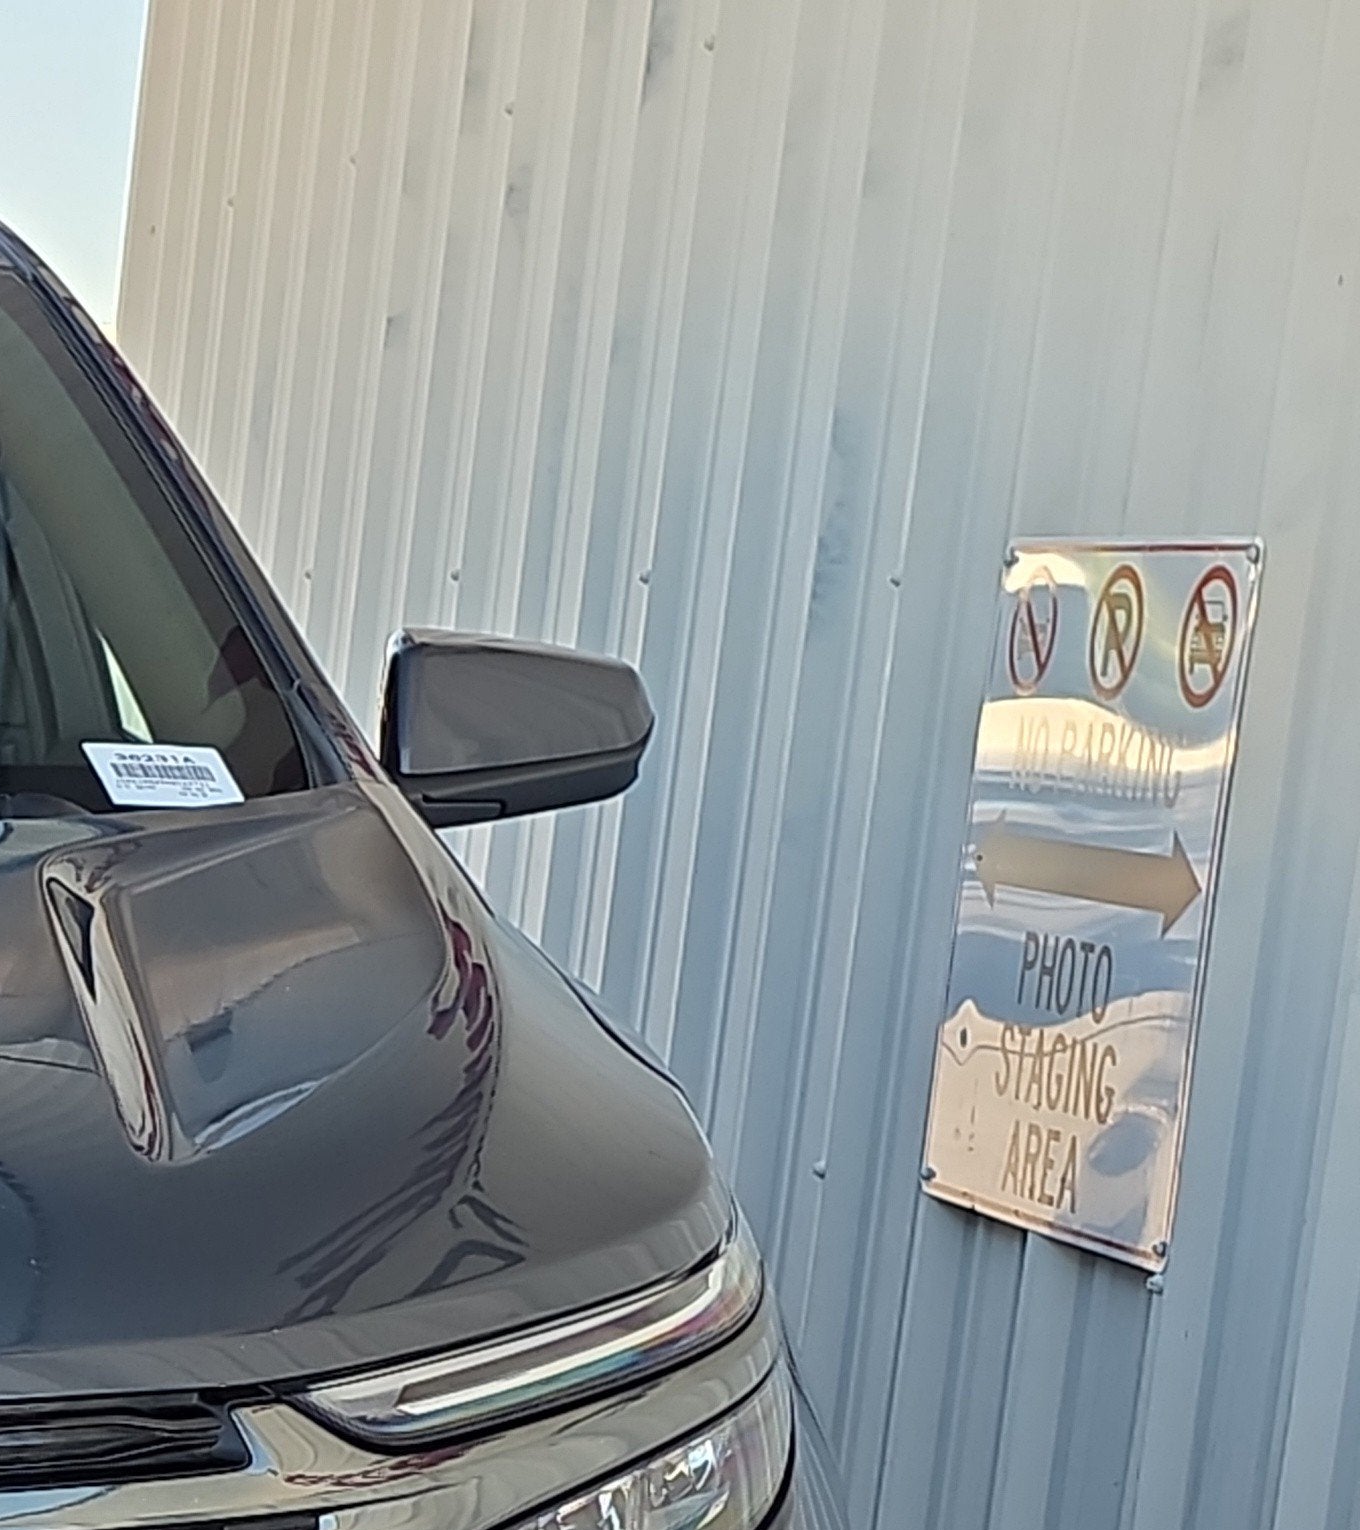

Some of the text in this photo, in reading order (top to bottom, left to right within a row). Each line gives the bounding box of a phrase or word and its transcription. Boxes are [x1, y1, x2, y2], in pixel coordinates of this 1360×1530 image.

[1017, 931, 1113, 1025] PHOTO
[995, 1023, 1117, 1125] STAGING
[1001, 1119, 1078, 1215] AREA
